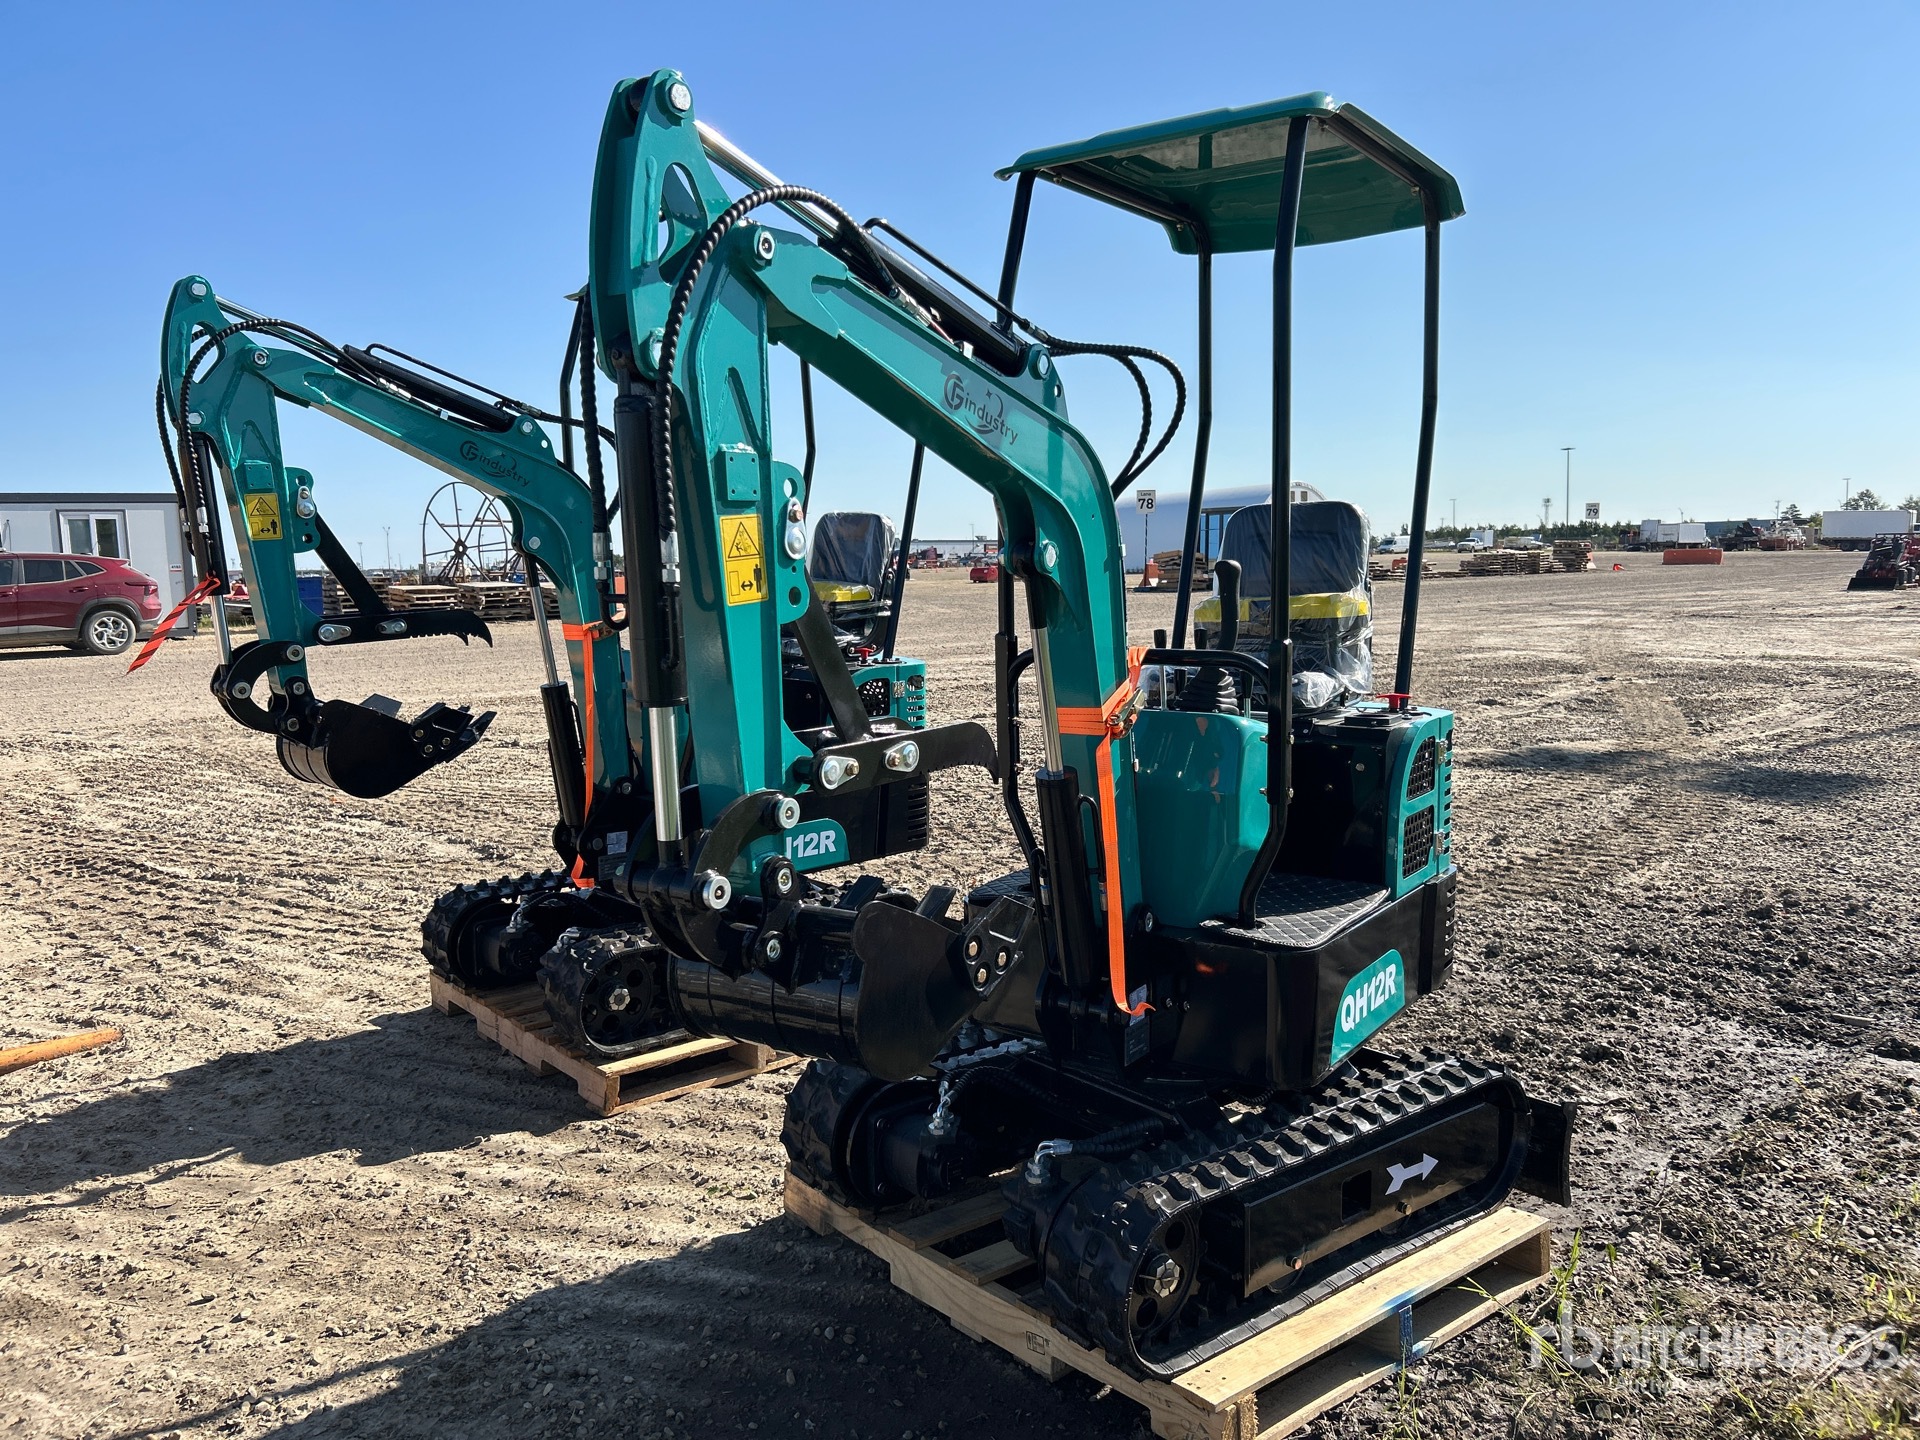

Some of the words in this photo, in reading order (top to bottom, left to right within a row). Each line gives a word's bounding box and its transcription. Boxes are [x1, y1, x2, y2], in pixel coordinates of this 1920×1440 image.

[964, 393, 1019, 446] industry
[480, 453, 531, 487] industry
[1138, 498, 1154, 510] 78
[1586, 508, 1599, 517] 79
[1341, 963, 1397, 1033] QH12R
